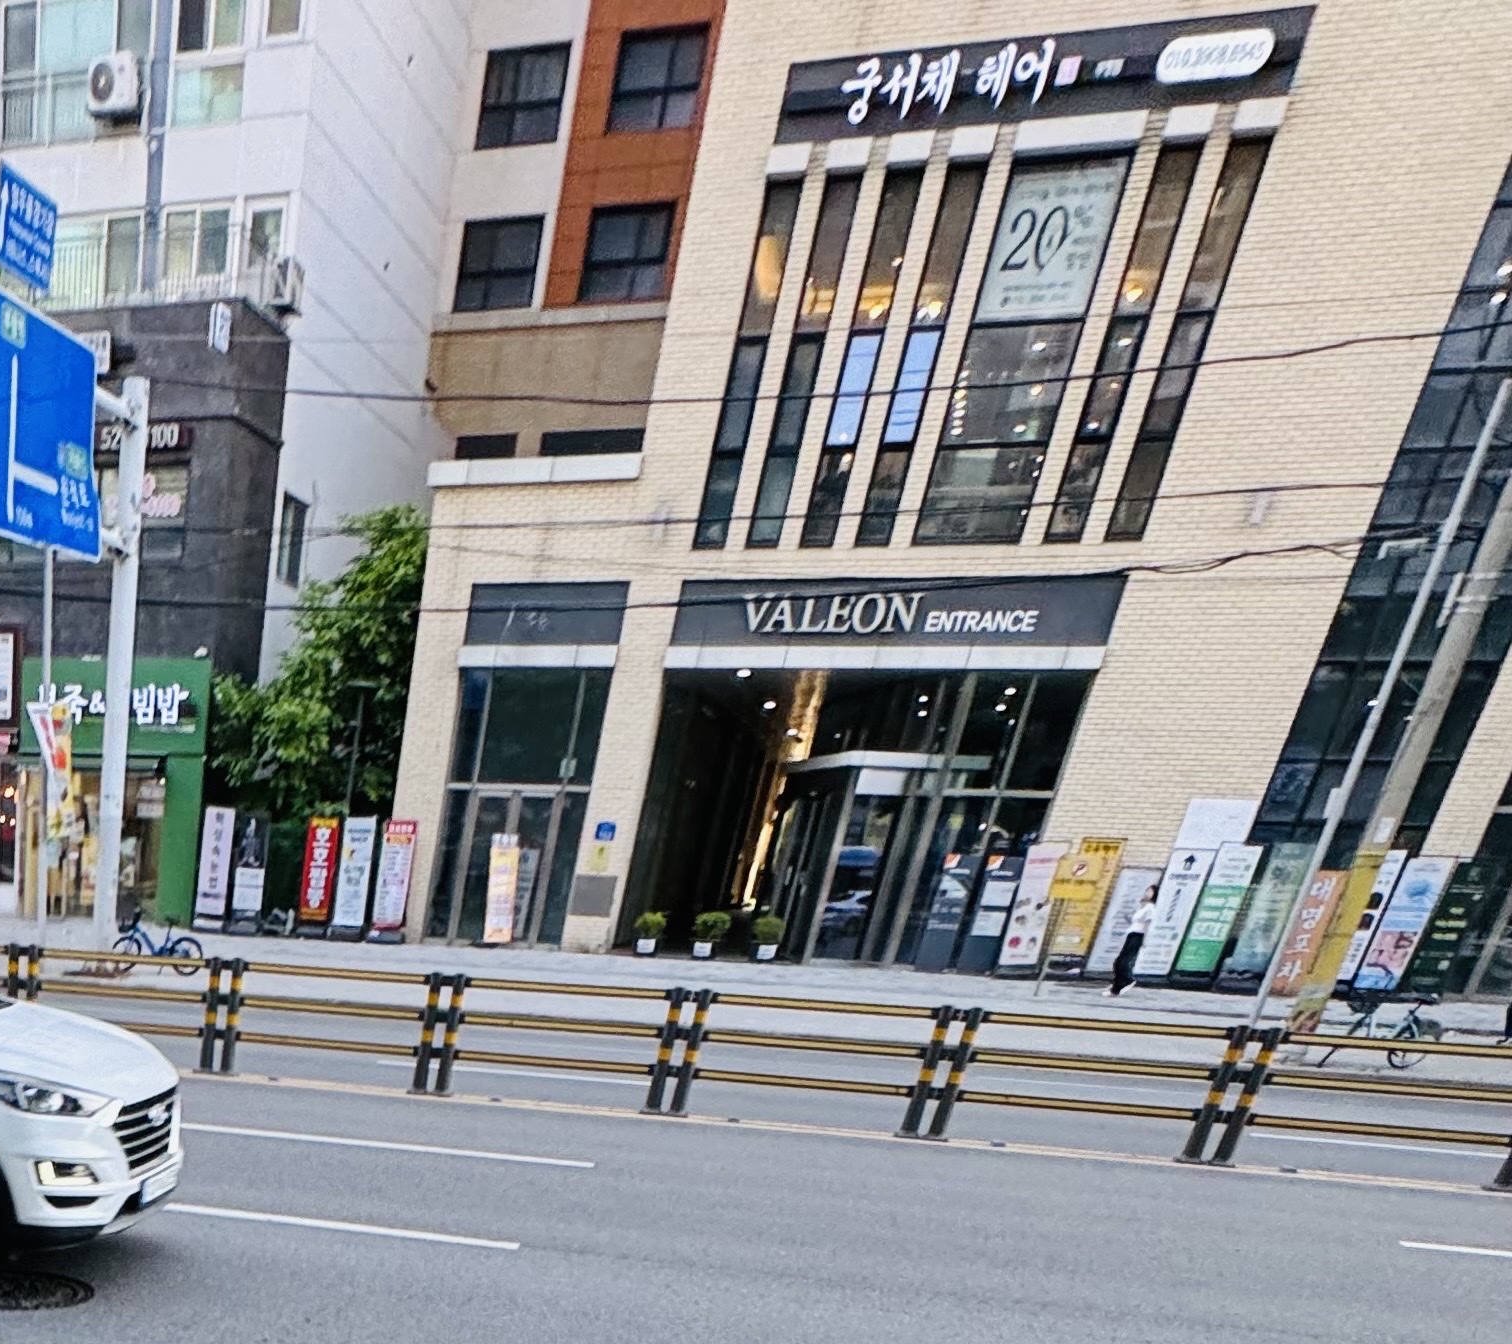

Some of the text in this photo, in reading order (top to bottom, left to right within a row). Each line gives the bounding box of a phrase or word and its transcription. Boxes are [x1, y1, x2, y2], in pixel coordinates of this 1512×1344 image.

[841, 38, 1056, 125] 궁서채 헤어
[742, 591, 1040, 633] VALEON ENTRANCE
